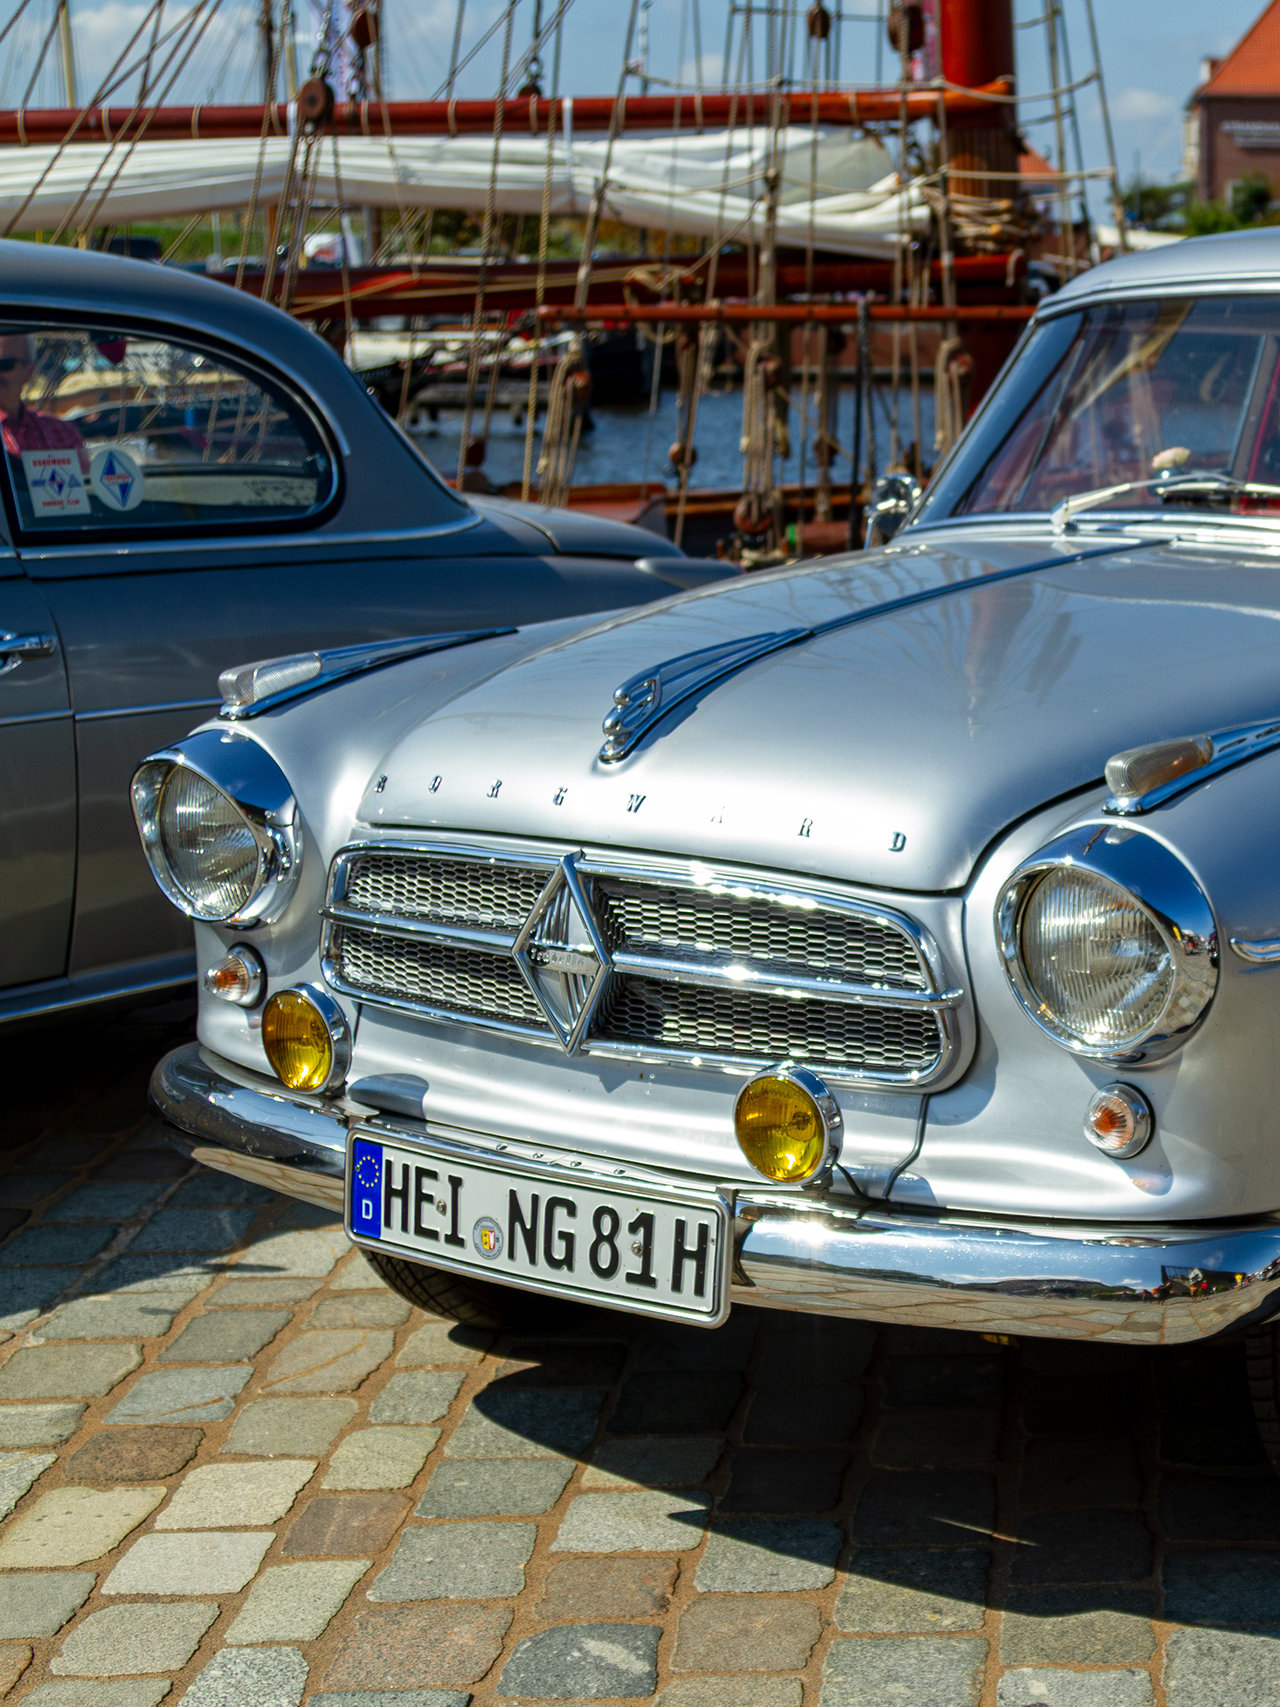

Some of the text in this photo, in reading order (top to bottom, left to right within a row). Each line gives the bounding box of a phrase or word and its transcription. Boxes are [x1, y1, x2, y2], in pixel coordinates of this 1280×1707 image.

[374, 774, 906, 852] BORGWARD
[362, 1199, 373, 1220] D
[384, 1159, 465, 1248] HEI
